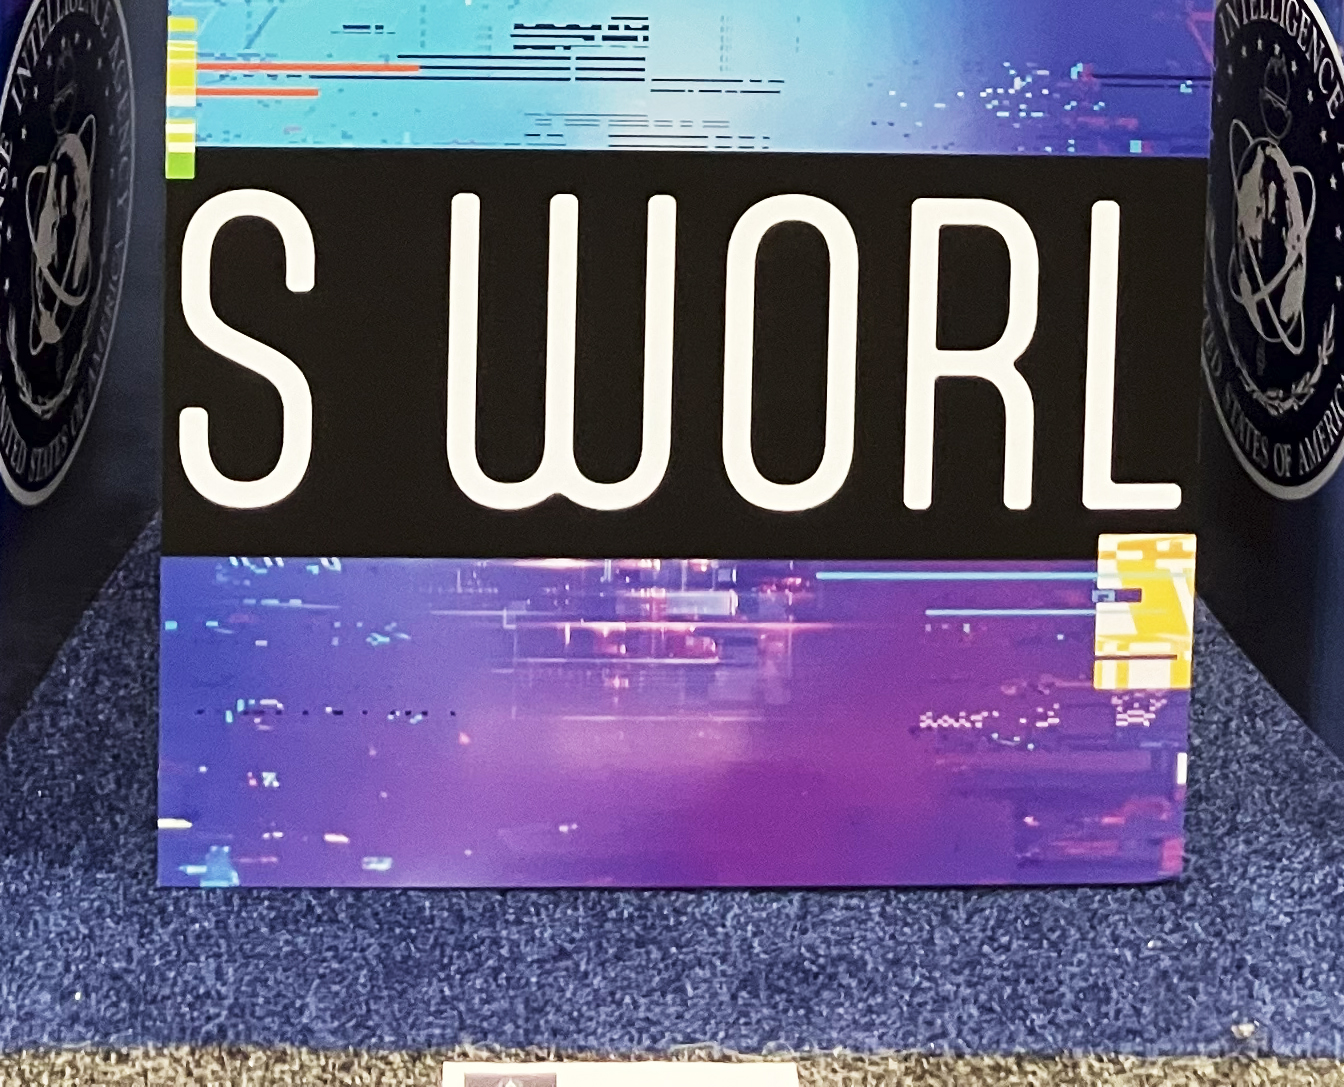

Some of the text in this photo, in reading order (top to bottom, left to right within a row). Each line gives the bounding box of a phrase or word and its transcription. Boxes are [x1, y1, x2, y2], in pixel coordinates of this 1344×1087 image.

[107, 35, 130, 208] AGENCY
[178, 188, 1183, 511] S WORL
[27, 424, 69, 483] STATES
[1224, 381, 1270, 469] STATES
[1272, 442, 1292, 478] OF
